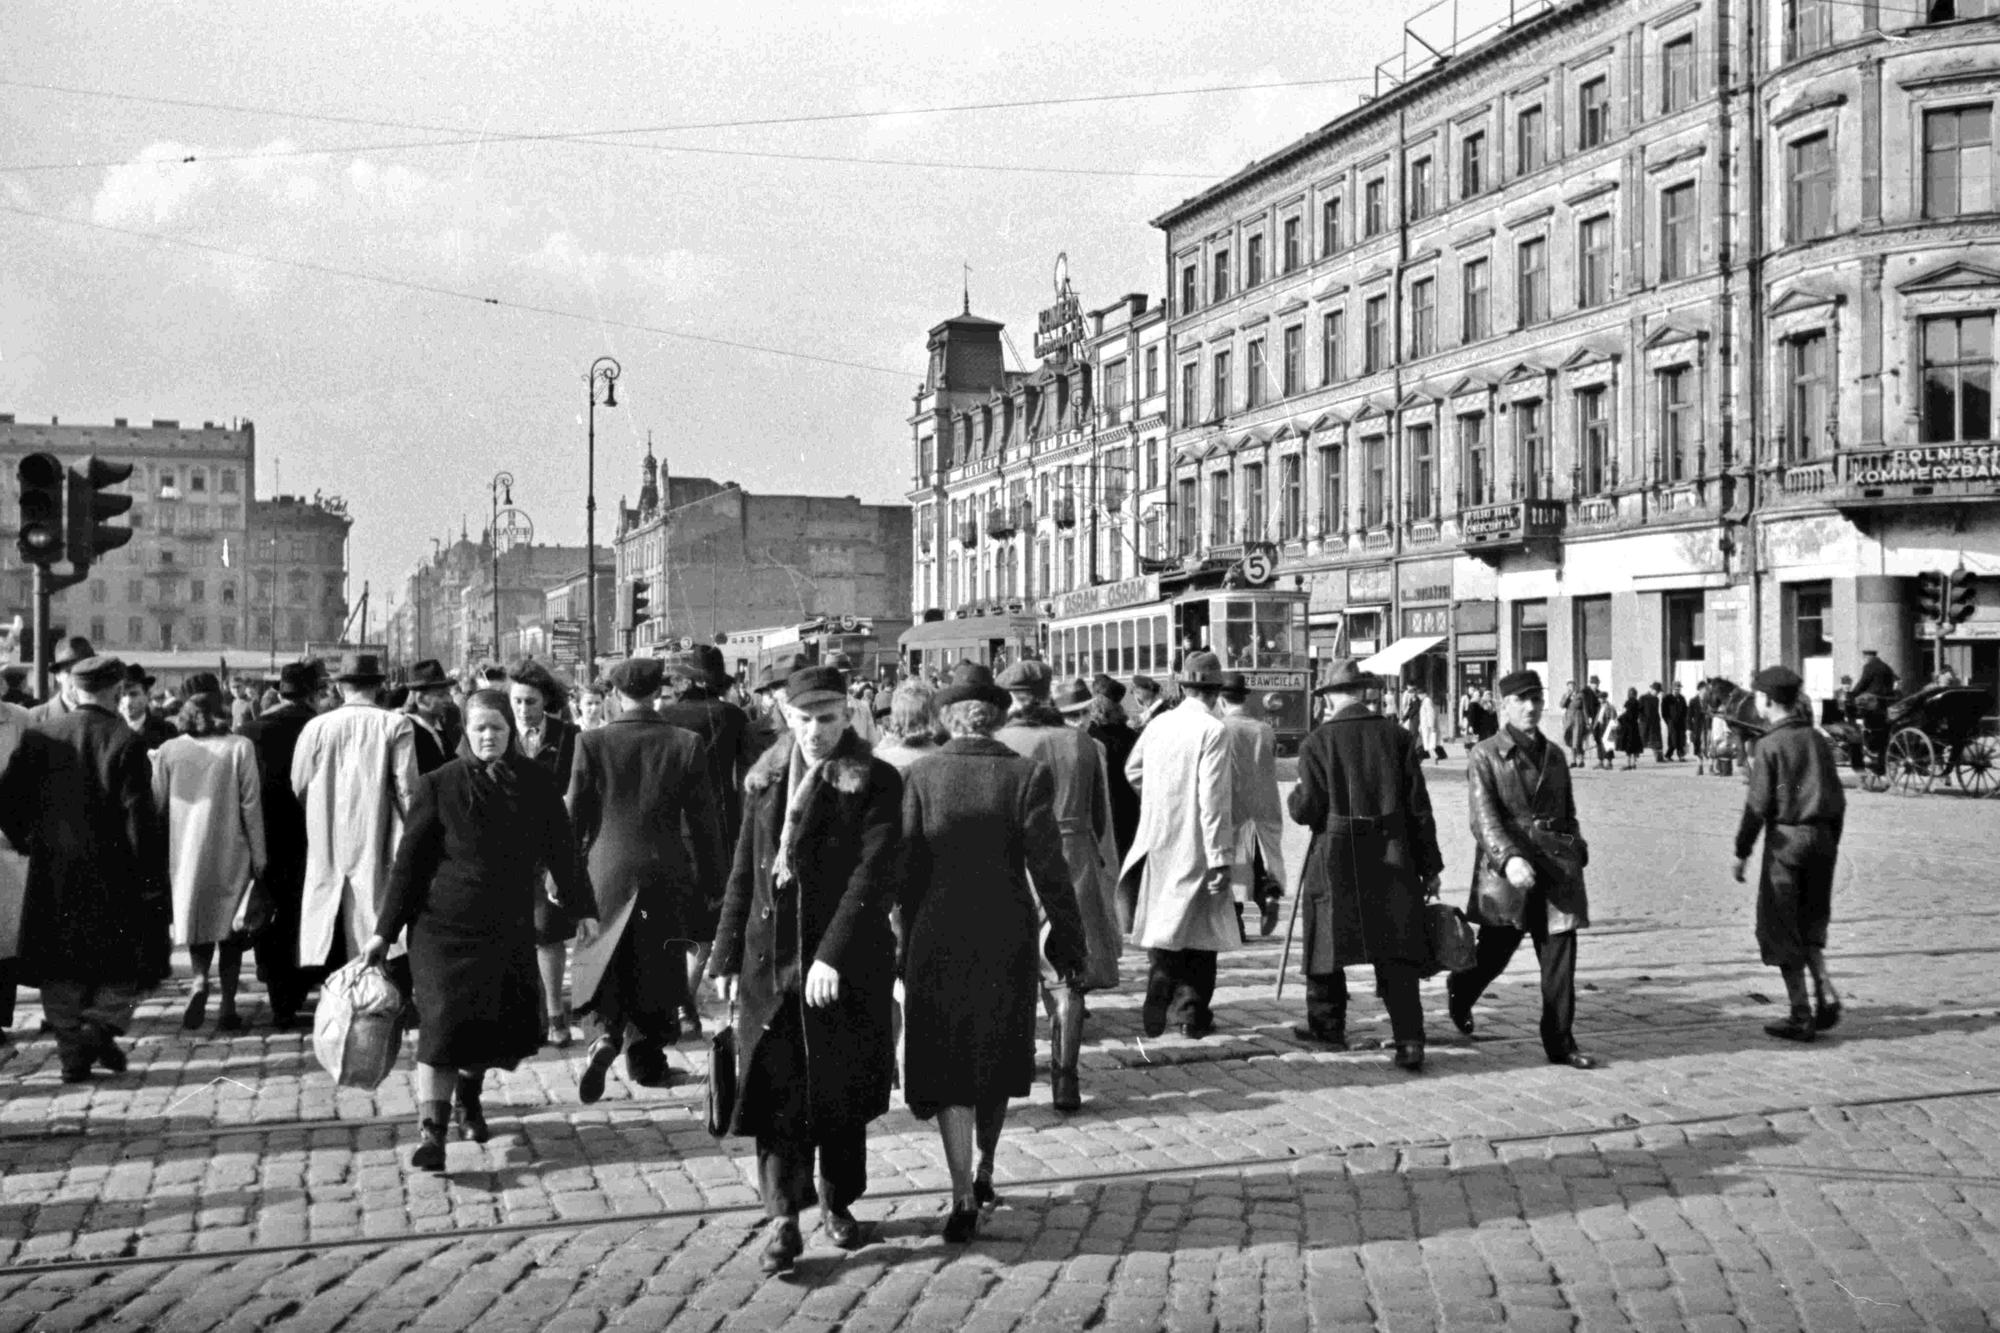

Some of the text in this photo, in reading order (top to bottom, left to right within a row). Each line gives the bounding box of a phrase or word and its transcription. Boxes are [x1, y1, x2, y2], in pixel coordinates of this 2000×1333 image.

[1249, 556, 1265, 579] 5
[1064, 579, 1147, 614] OSRAM OSRAM
